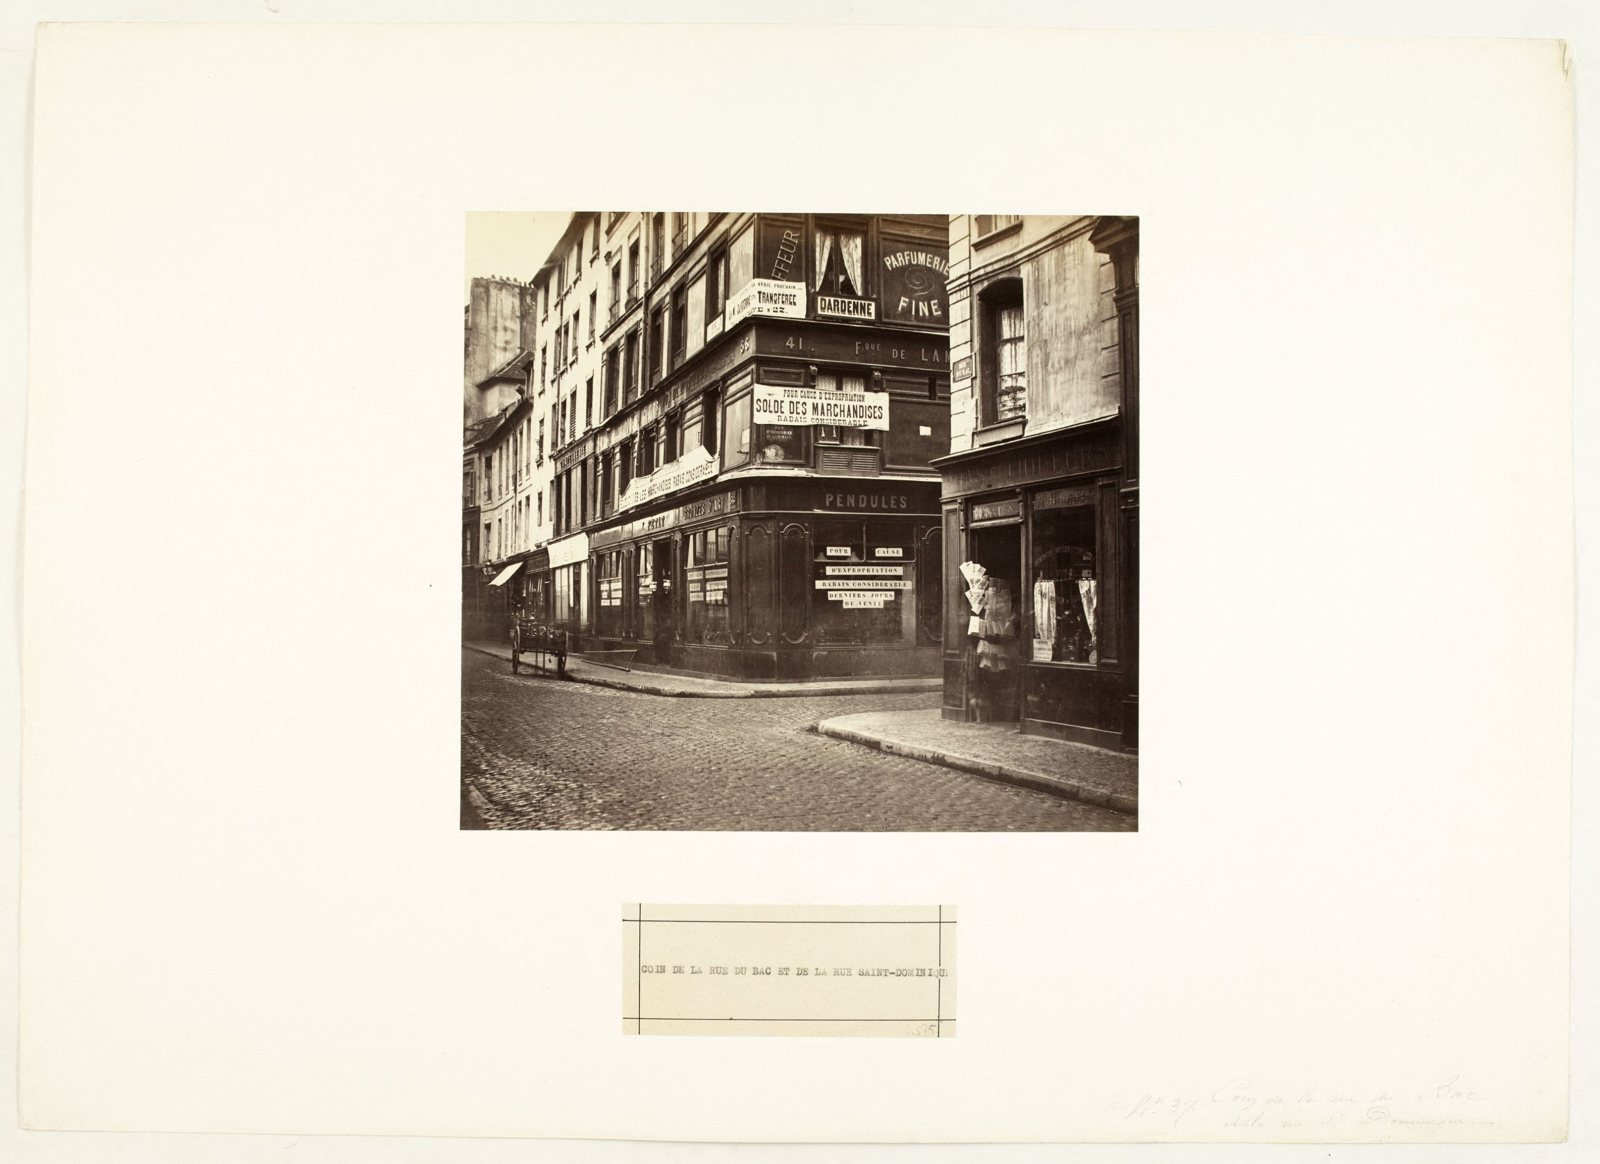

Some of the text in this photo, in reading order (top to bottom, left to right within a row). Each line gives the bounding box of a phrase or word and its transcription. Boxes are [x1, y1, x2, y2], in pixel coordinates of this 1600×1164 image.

[884, 251, 950, 276] PARFUMERIE
[819, 297, 873, 317] DARDENNE
[897, 296, 942, 317] FINE
[892, 348, 906, 360] DE
[783, 389, 798, 399] POUR
[800, 390, 817, 400] CAUSE
[755, 398, 883, 420] SOLDE DES MARCHANDISES
[777, 414, 868, 427] RABAIS CONSIDERABLE
[825, 493, 908, 509] PENDULES
[829, 547, 849, 555] POUR
[641, 965, 948, 979] COIN DE LA RUE DU BAC ET DE LA RUE SAINT-DOMINIQU
